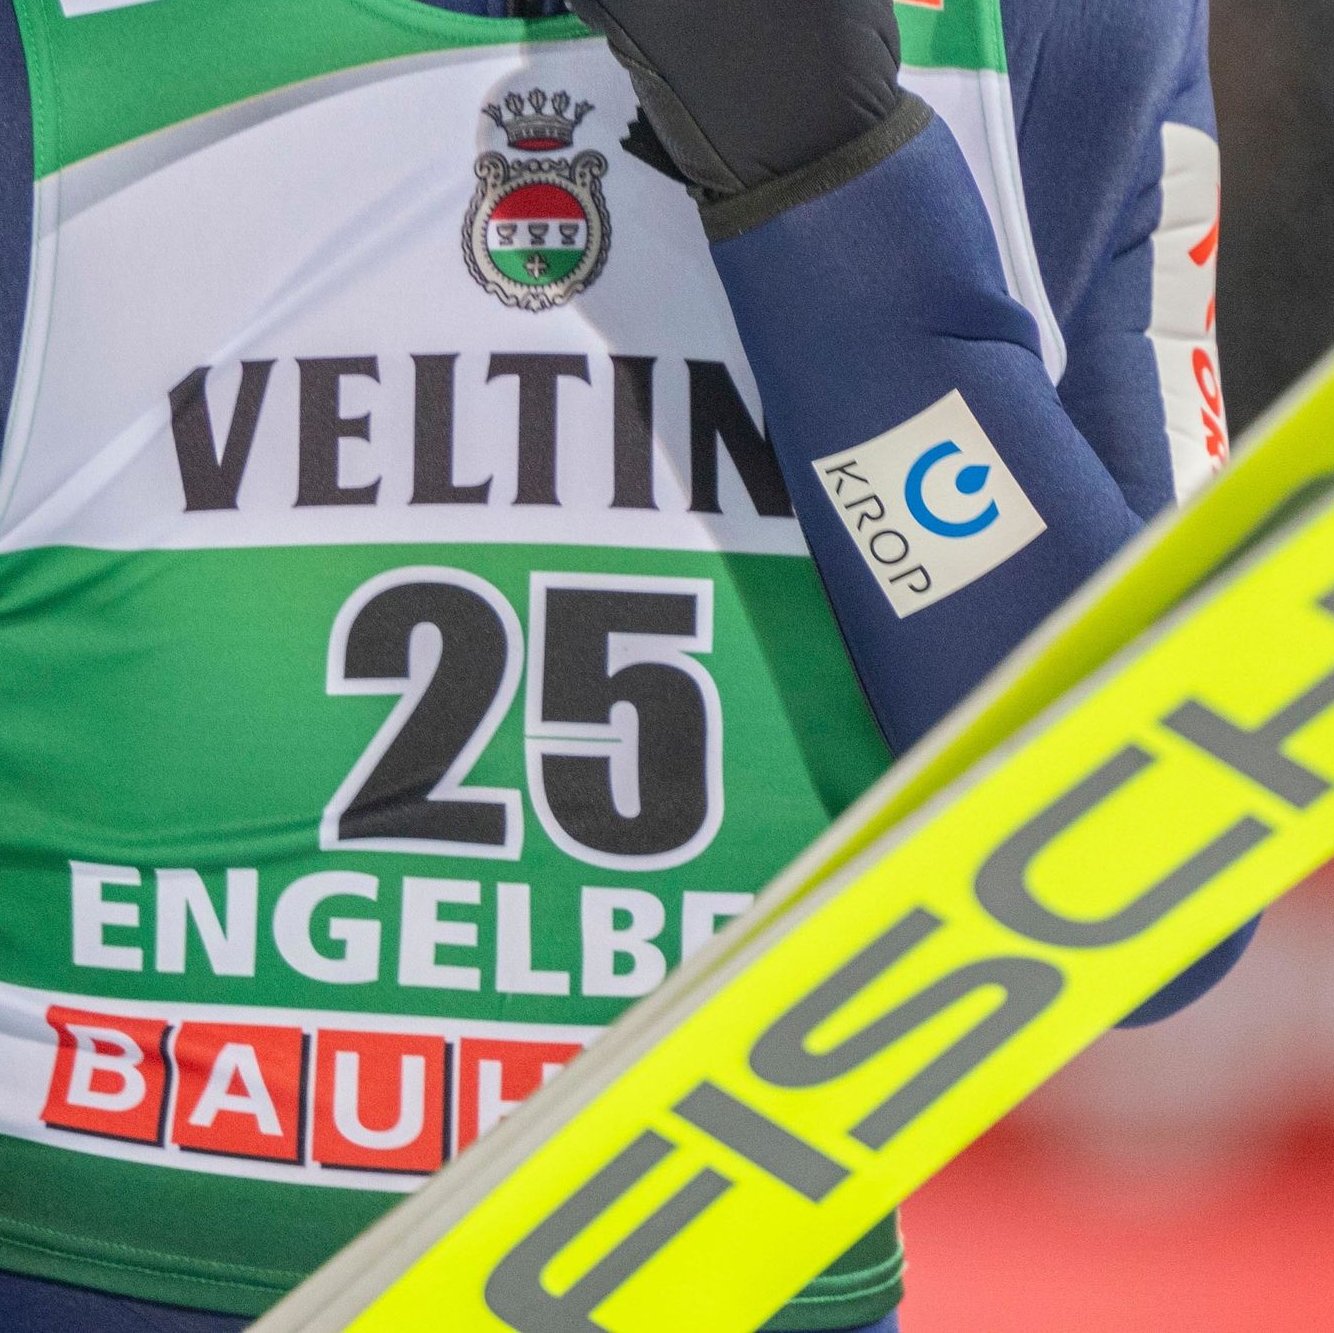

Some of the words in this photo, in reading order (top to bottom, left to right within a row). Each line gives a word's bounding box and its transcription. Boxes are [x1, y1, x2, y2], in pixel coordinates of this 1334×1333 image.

[168, 351, 799, 519] VELTIN
[824, 459, 934, 597] KROP
[320, 566, 725, 871] 25
